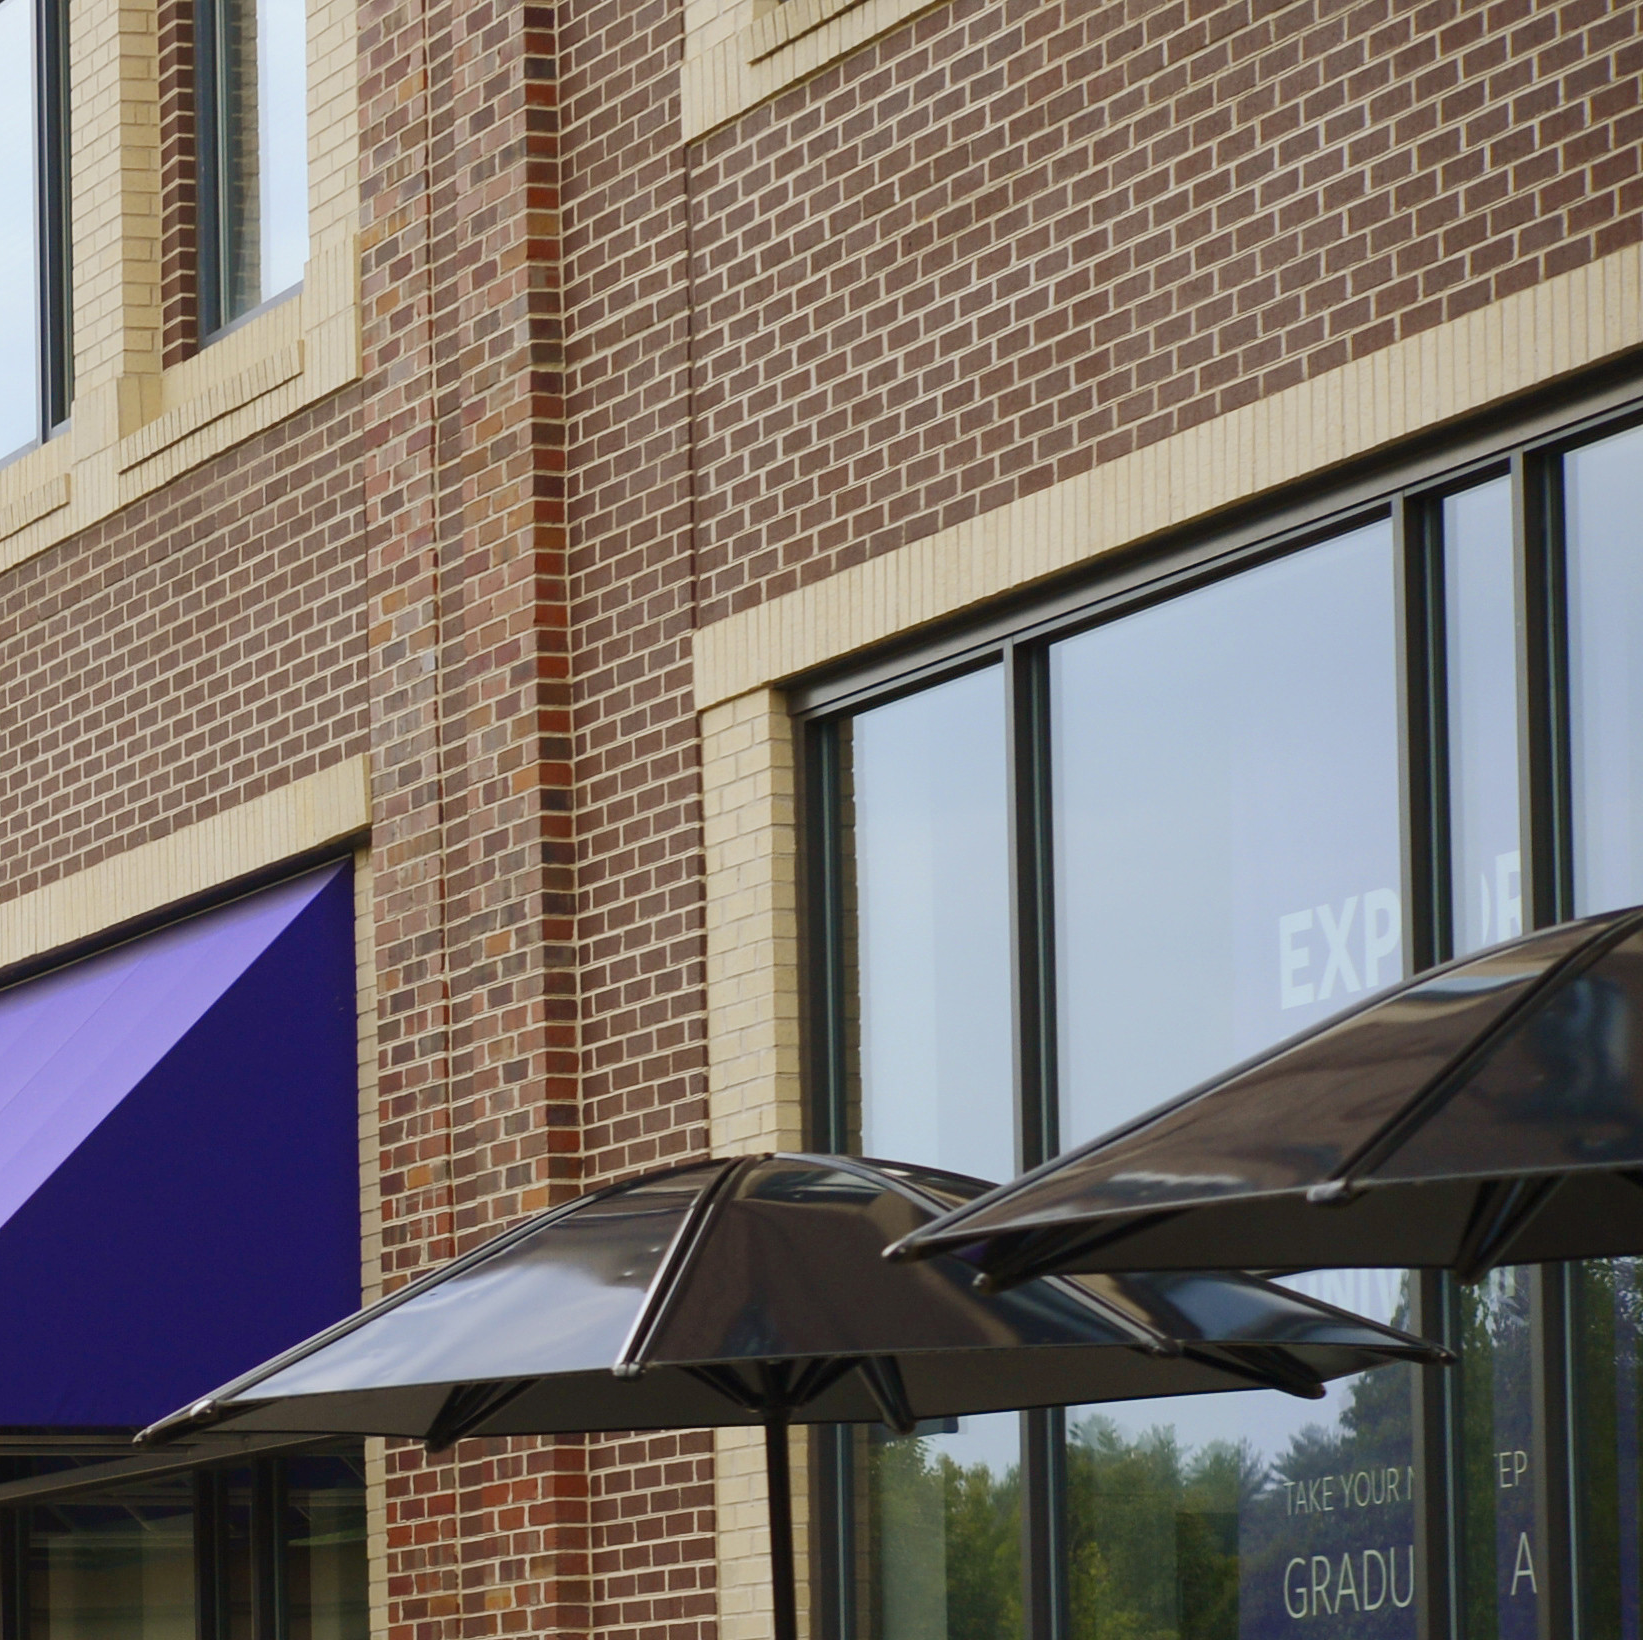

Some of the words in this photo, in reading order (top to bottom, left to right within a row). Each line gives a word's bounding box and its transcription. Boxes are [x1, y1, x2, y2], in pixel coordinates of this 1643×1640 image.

[1282, 1475, 1334, 1516] TAKE
[1341, 1467, 1400, 1508] YOUR
[1283, 1544, 1415, 1620] GRADU
